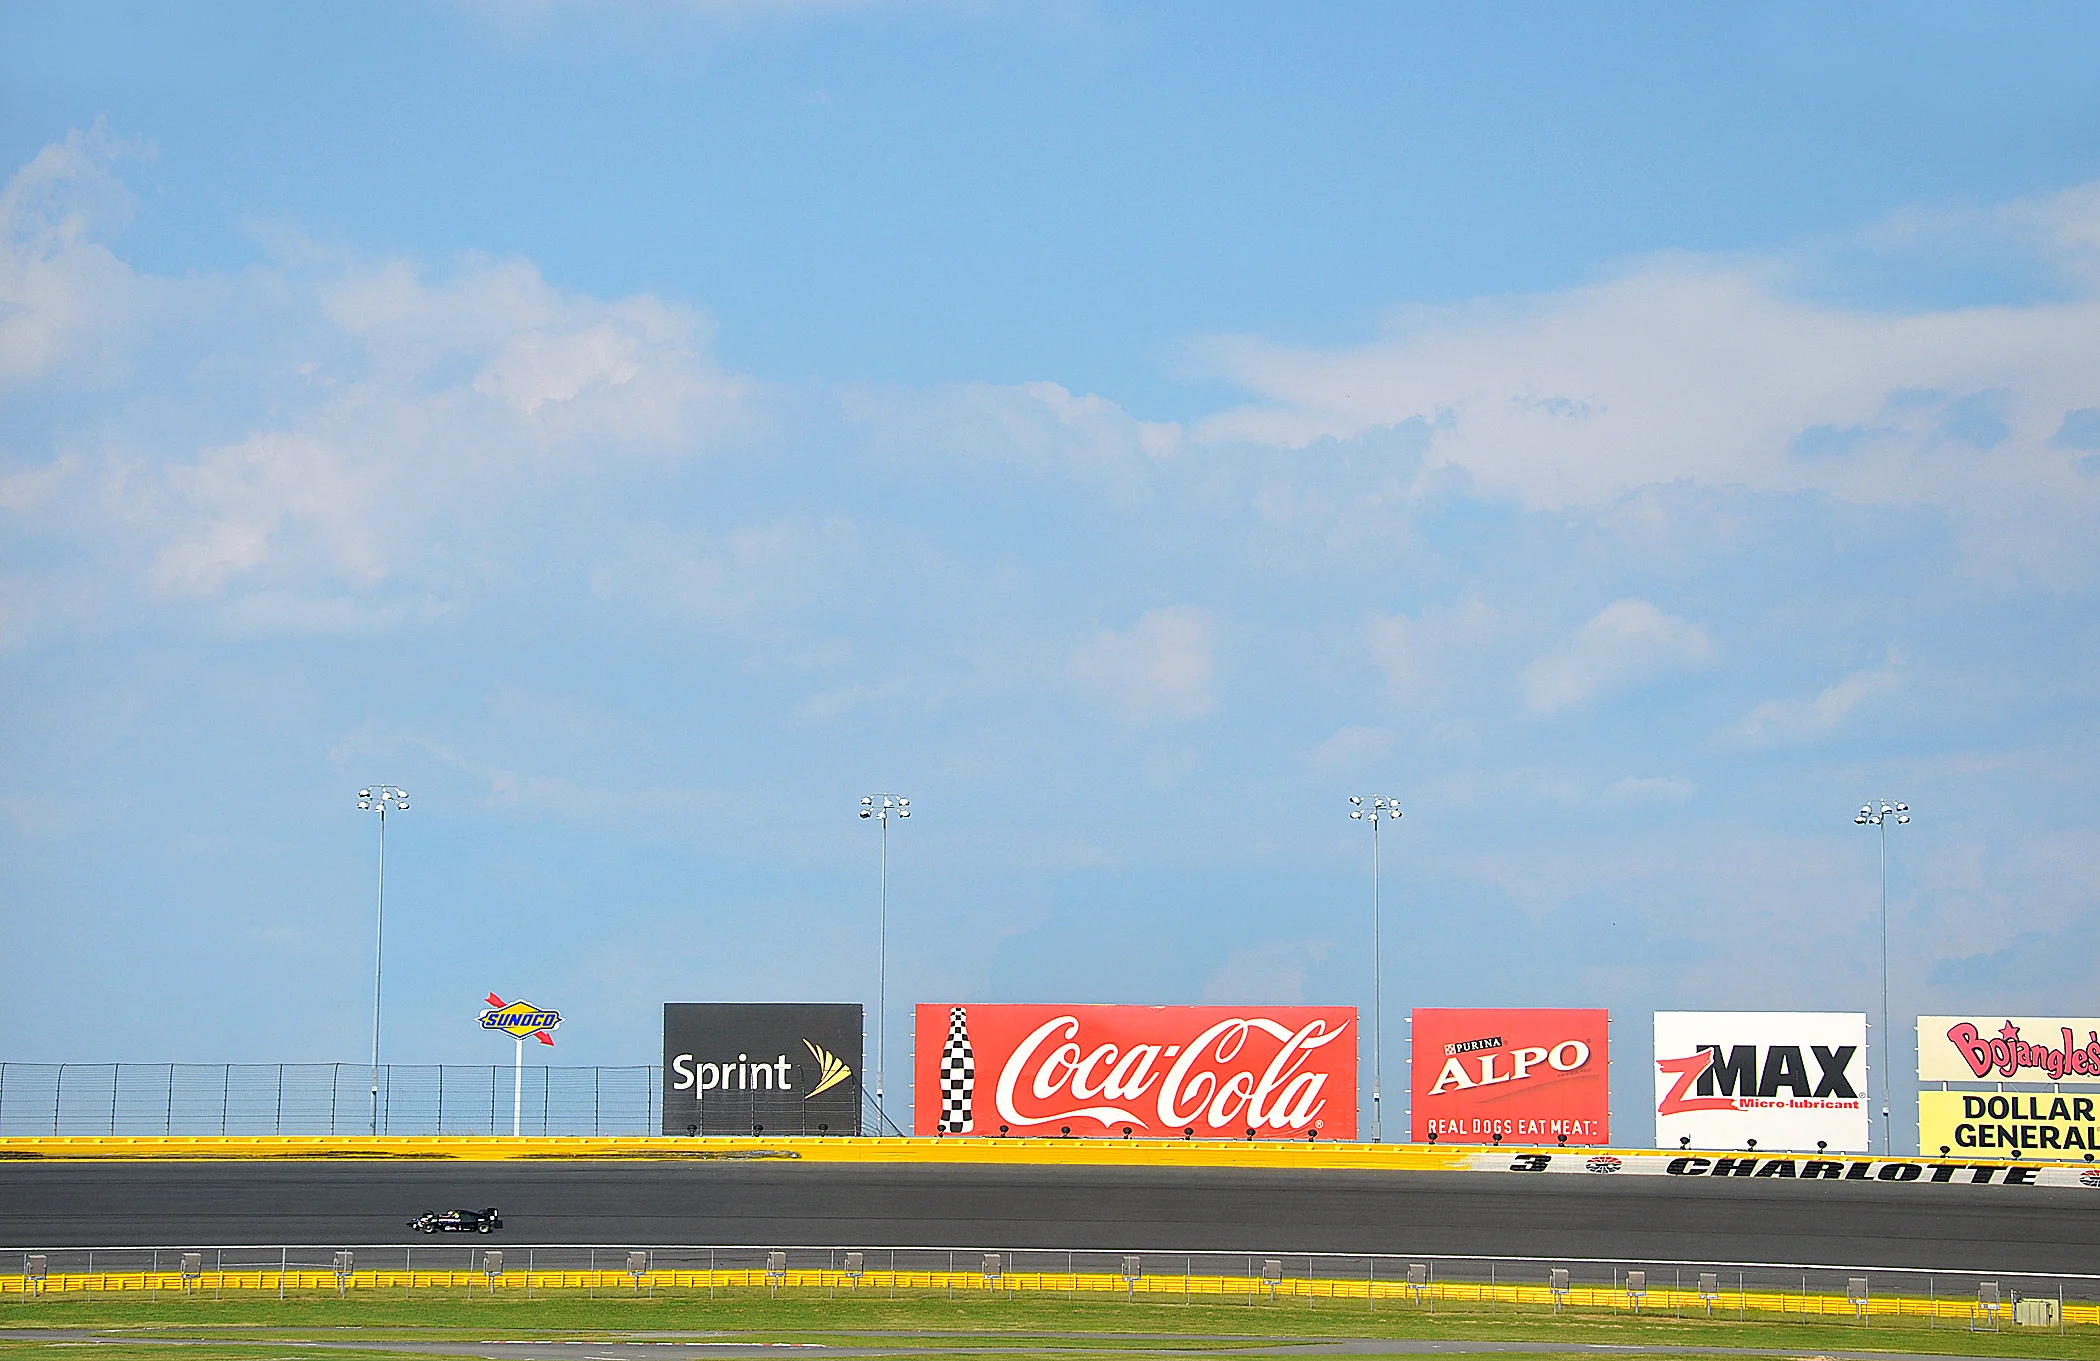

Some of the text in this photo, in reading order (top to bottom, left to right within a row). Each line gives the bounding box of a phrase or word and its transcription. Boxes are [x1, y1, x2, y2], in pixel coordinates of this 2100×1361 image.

[485, 1013, 556, 1026] SUNOCO
[1456, 1038, 1501, 1052] PURINA
[672, 1053, 792, 1099] Sprint
[996, 1015, 1351, 1129] Coca-Cola
[1427, 1039, 1590, 1096] ALPO
[1739, 1098, 1860, 1109] Micro-lubricant
[1963, 1096, 2096, 1121] DOLLAR
[1428, 1119, 1468, 1135] REAL
[1472, 1119, 1512, 1135] DOGS
[1518, 1119, 1547, 1135] EAT
[1955, 1124, 2100, 1150] GENERAL
[1509, 1154, 1552, 1172] 3
[1666, 1157, 2041, 1185] CHARLOTTE
